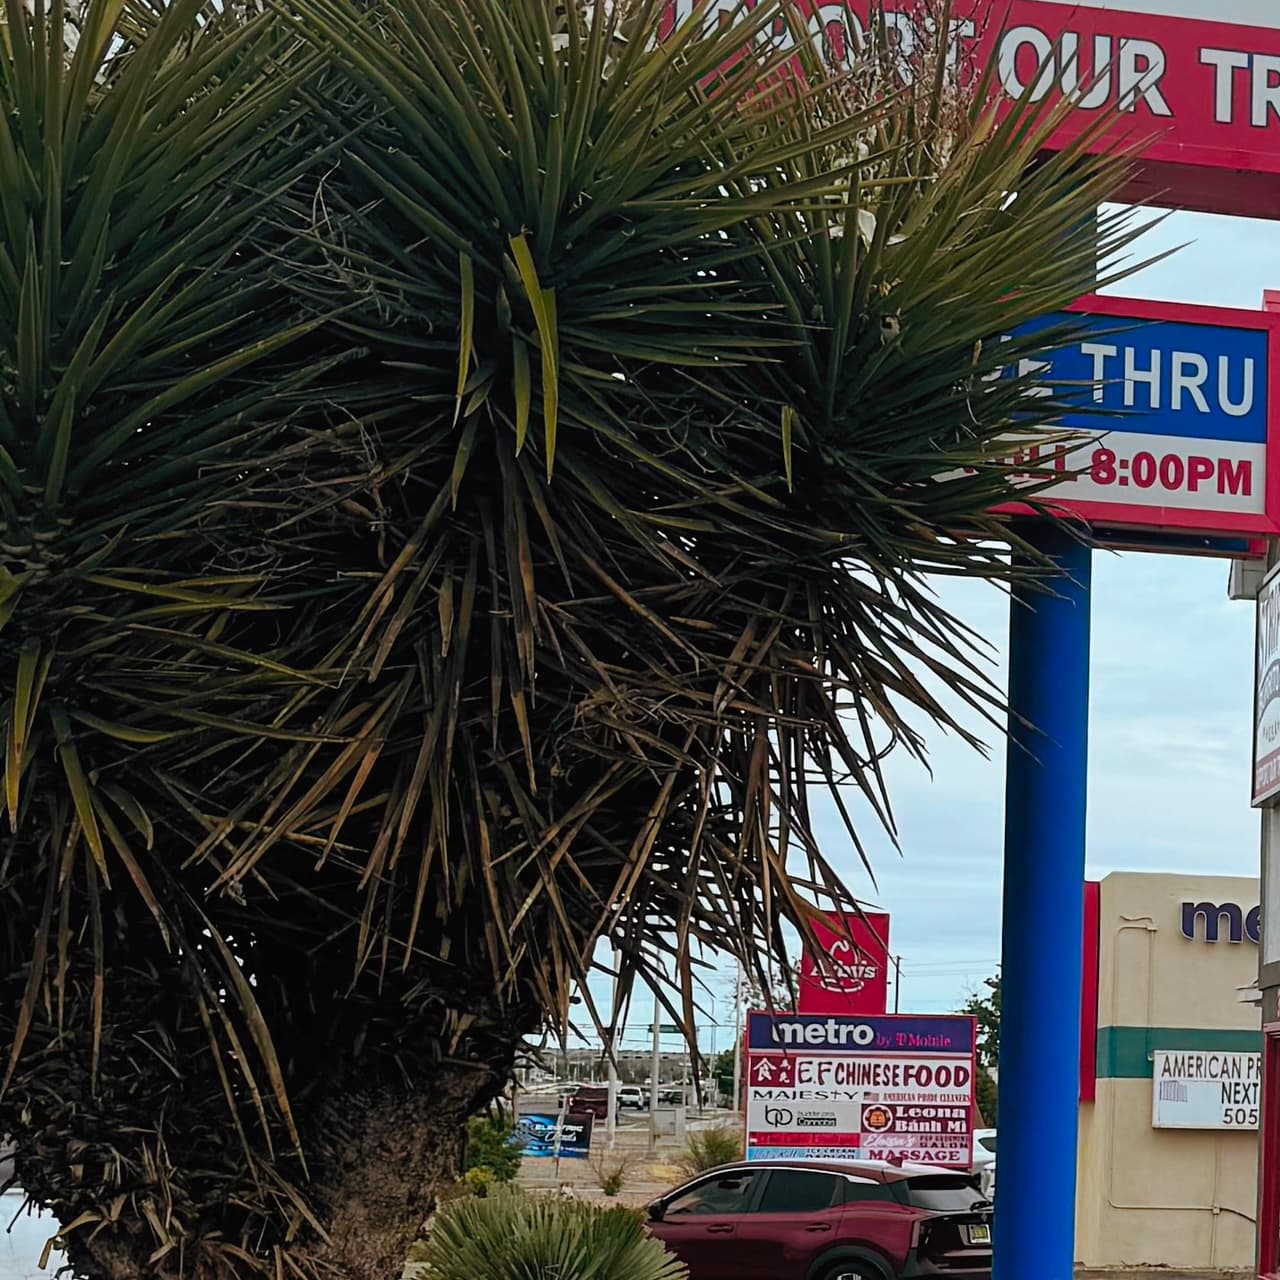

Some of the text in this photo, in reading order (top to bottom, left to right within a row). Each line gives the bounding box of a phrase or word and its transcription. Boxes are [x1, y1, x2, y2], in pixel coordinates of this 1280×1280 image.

[998, 25, 1173, 117] OUR
[1080, 342, 1255, 417] THRU
[1090, 447, 1253, 497] 8:00PM
[772, 1018, 875, 1046] metro
[834, 1061, 900, 1087] CHINESE
[903, 1064, 970, 1088] FOOD
[1161, 1054, 1243, 1079] AMERICAN
[1221, 1081, 1259, 1105] NEXT
[896, 1105, 966, 1119] Leona
[1223, 1108, 1259, 1125] 505
[868, 1149, 960, 1161] MASSAGE
